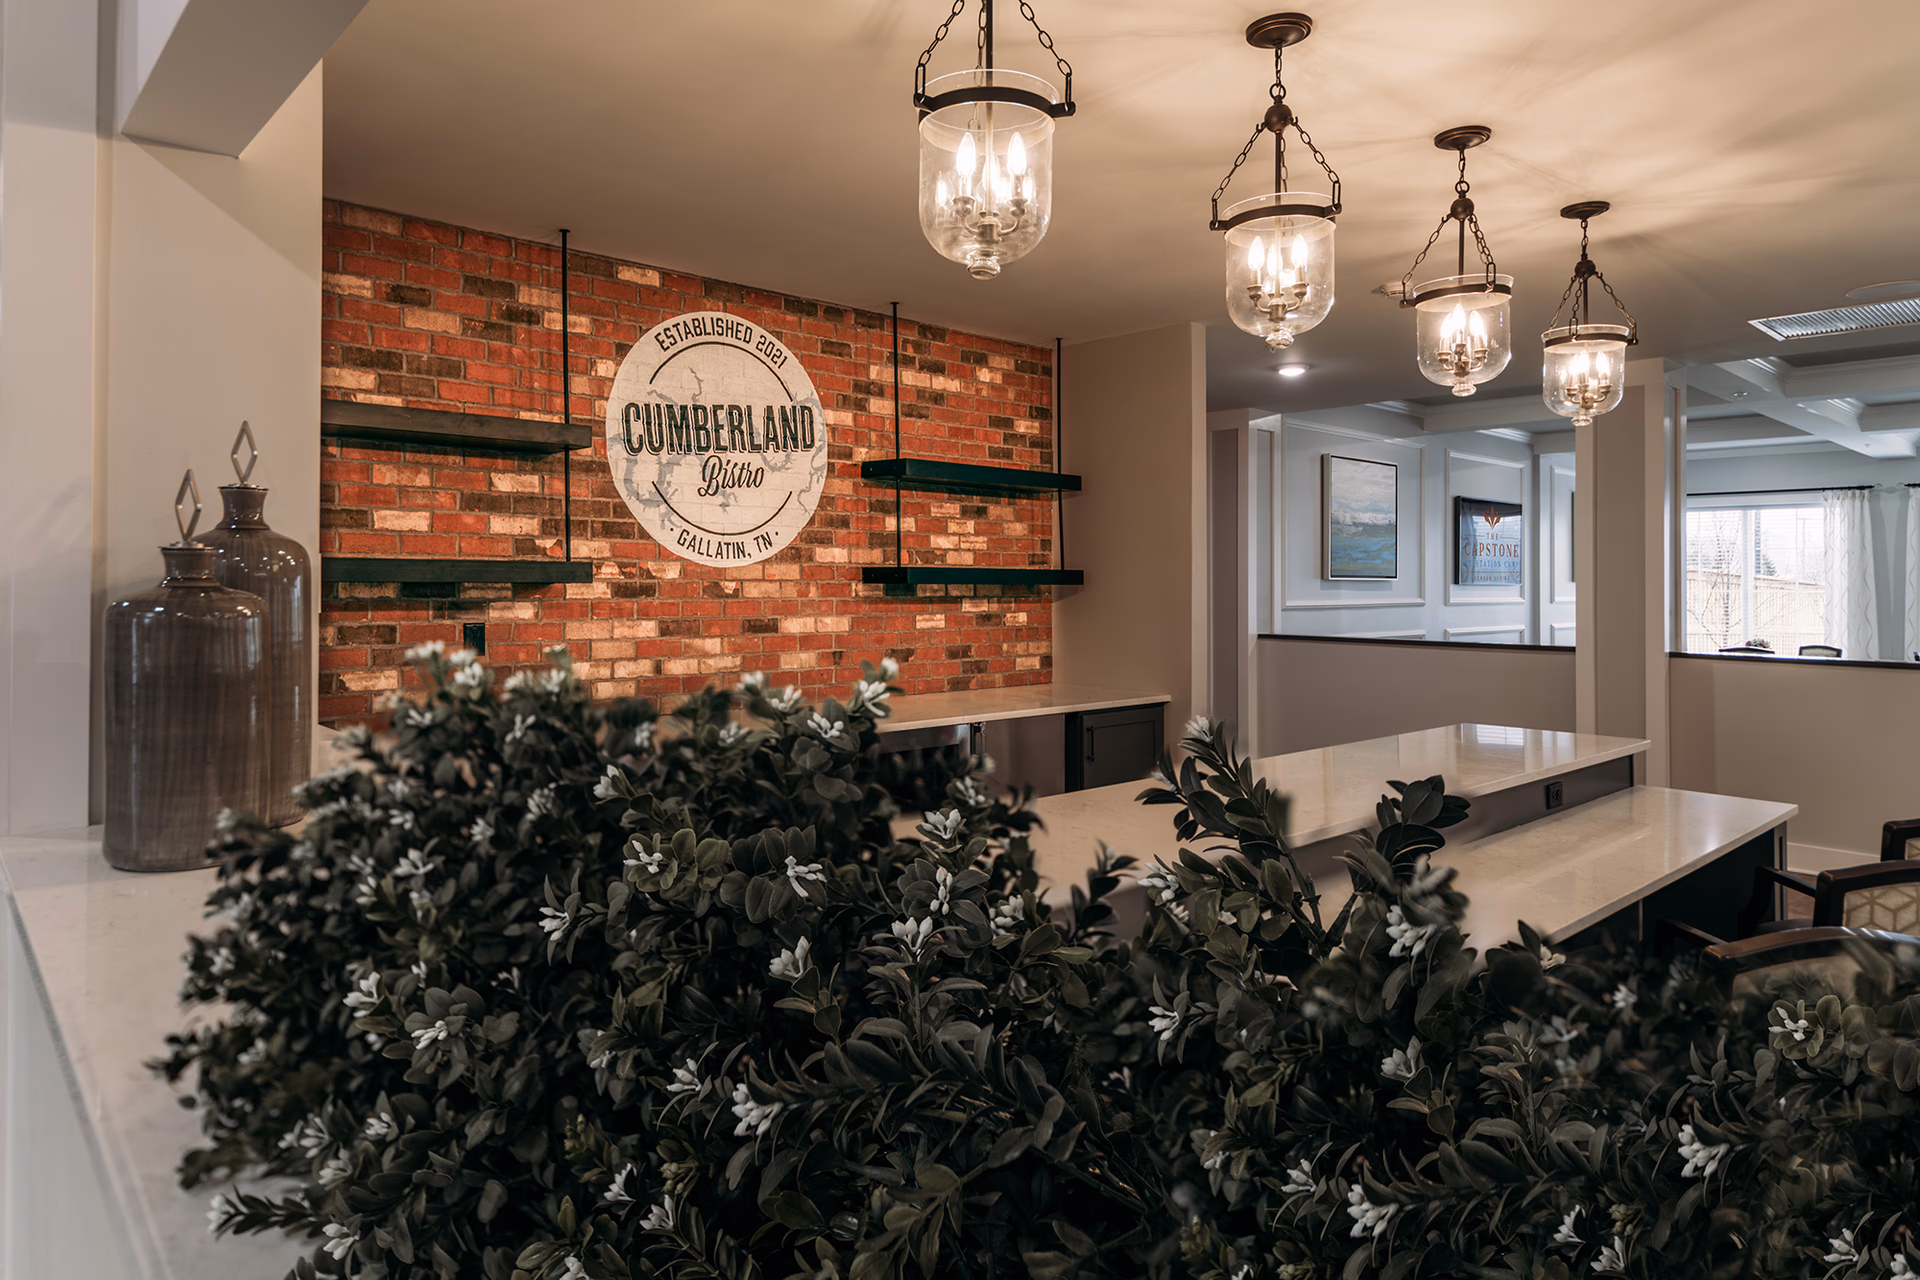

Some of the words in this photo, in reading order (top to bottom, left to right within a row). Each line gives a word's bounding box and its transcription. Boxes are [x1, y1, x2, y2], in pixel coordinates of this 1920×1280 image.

[654, 317, 752, 352] ESTABLISHED
[755, 335, 788, 370] 2021
[622, 402, 815, 456] CUMBERLAND
[698, 455, 765, 496] Bistro
[677, 528, 752, 560] GALLATIN,
[1464, 542, 1519, 557] CAPSTONE
[1476, 560, 1501, 568] STATION
